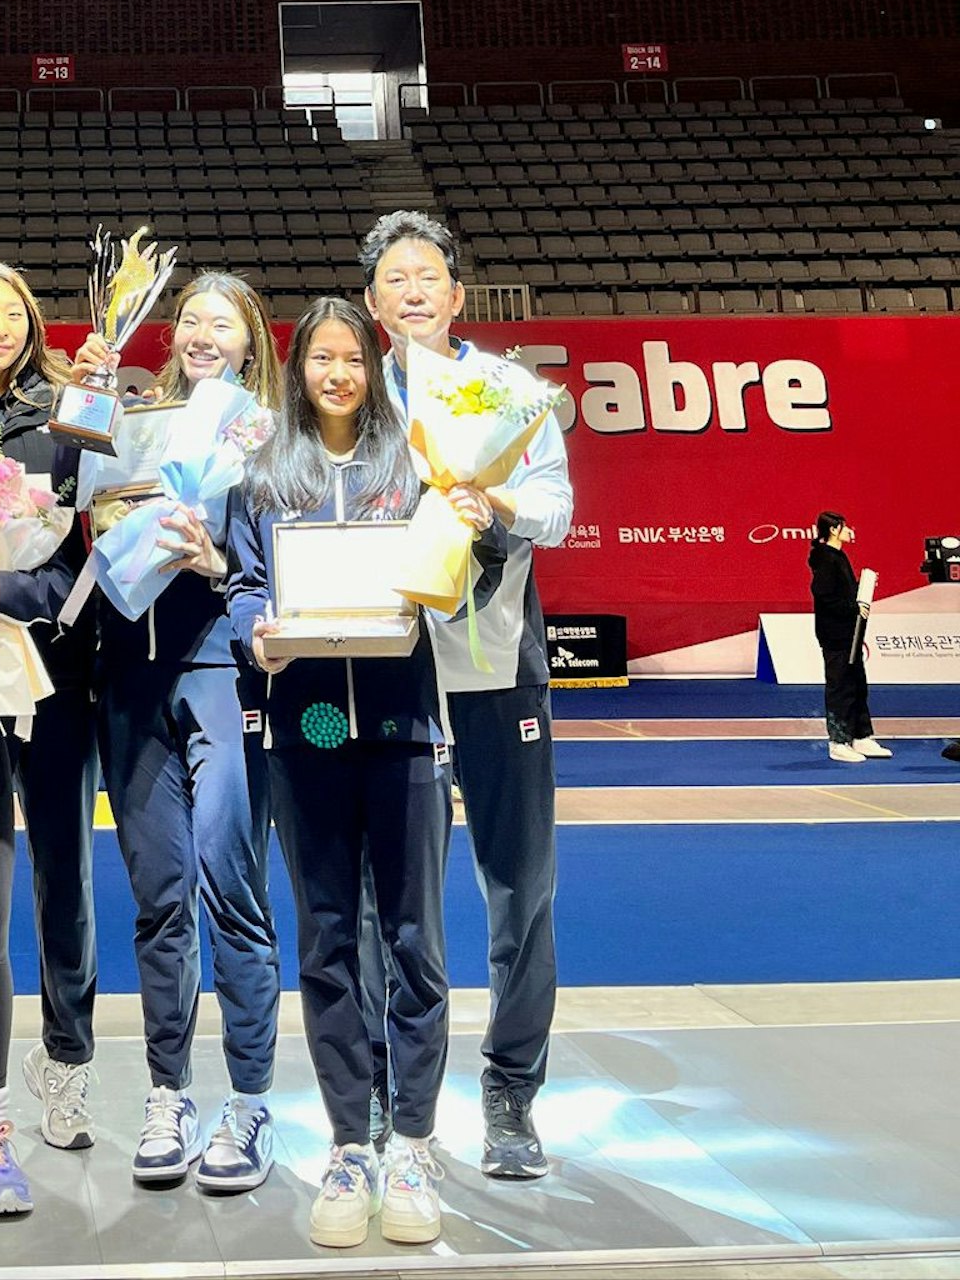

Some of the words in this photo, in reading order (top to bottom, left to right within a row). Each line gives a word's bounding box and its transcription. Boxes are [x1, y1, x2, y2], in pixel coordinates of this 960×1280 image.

[630, 56, 661, 69] 2-14
[38, 66, 69, 79] 2-13
[618, 527, 666, 543] BNK
[667, 526, 725, 542] 부산은행
[567, 539, 601, 549] Council
[551, 656, 566, 668] SK
[568, 658, 599, 668] telecom
